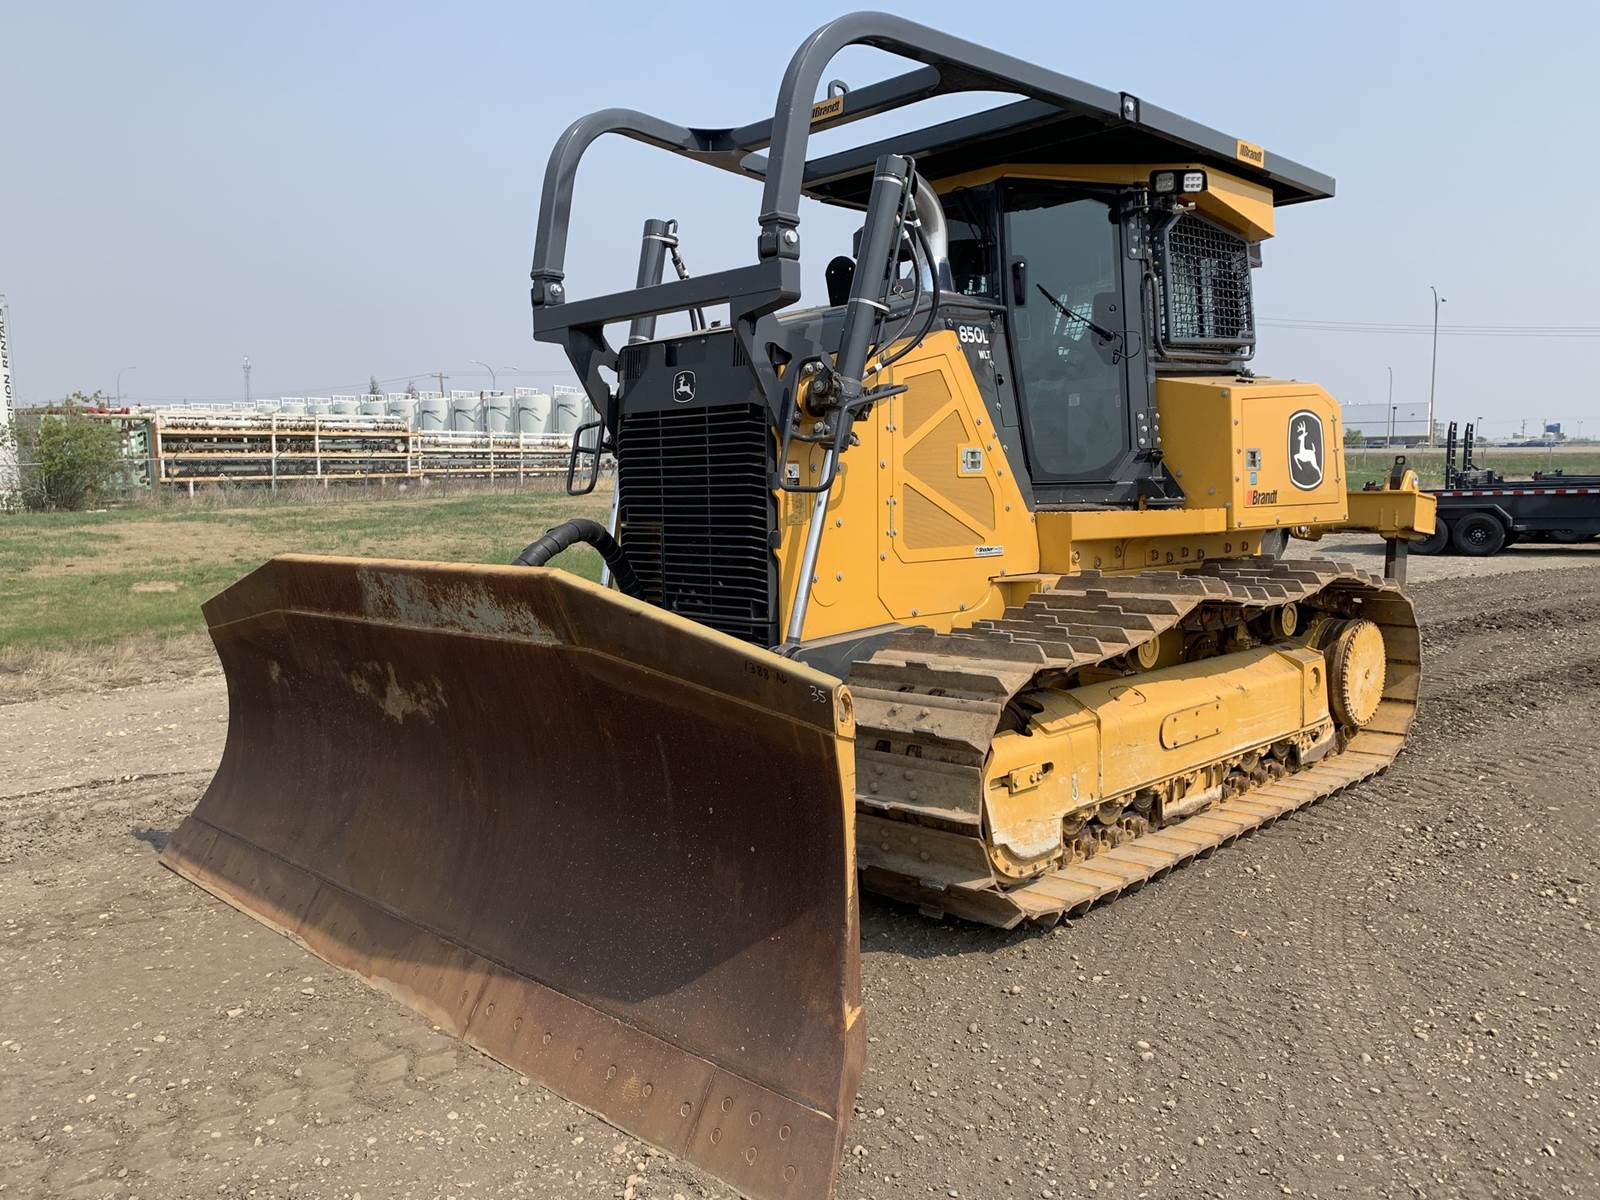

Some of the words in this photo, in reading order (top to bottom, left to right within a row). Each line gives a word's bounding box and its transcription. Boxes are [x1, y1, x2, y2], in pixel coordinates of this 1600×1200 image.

[813, 101, 840, 117] Brandt
[959, 325, 989, 344] 850L
[3, 374, 16, 447] PRCISION
[1252, 490, 1278, 505] Brandt
[809, 685, 827, 703] 35
